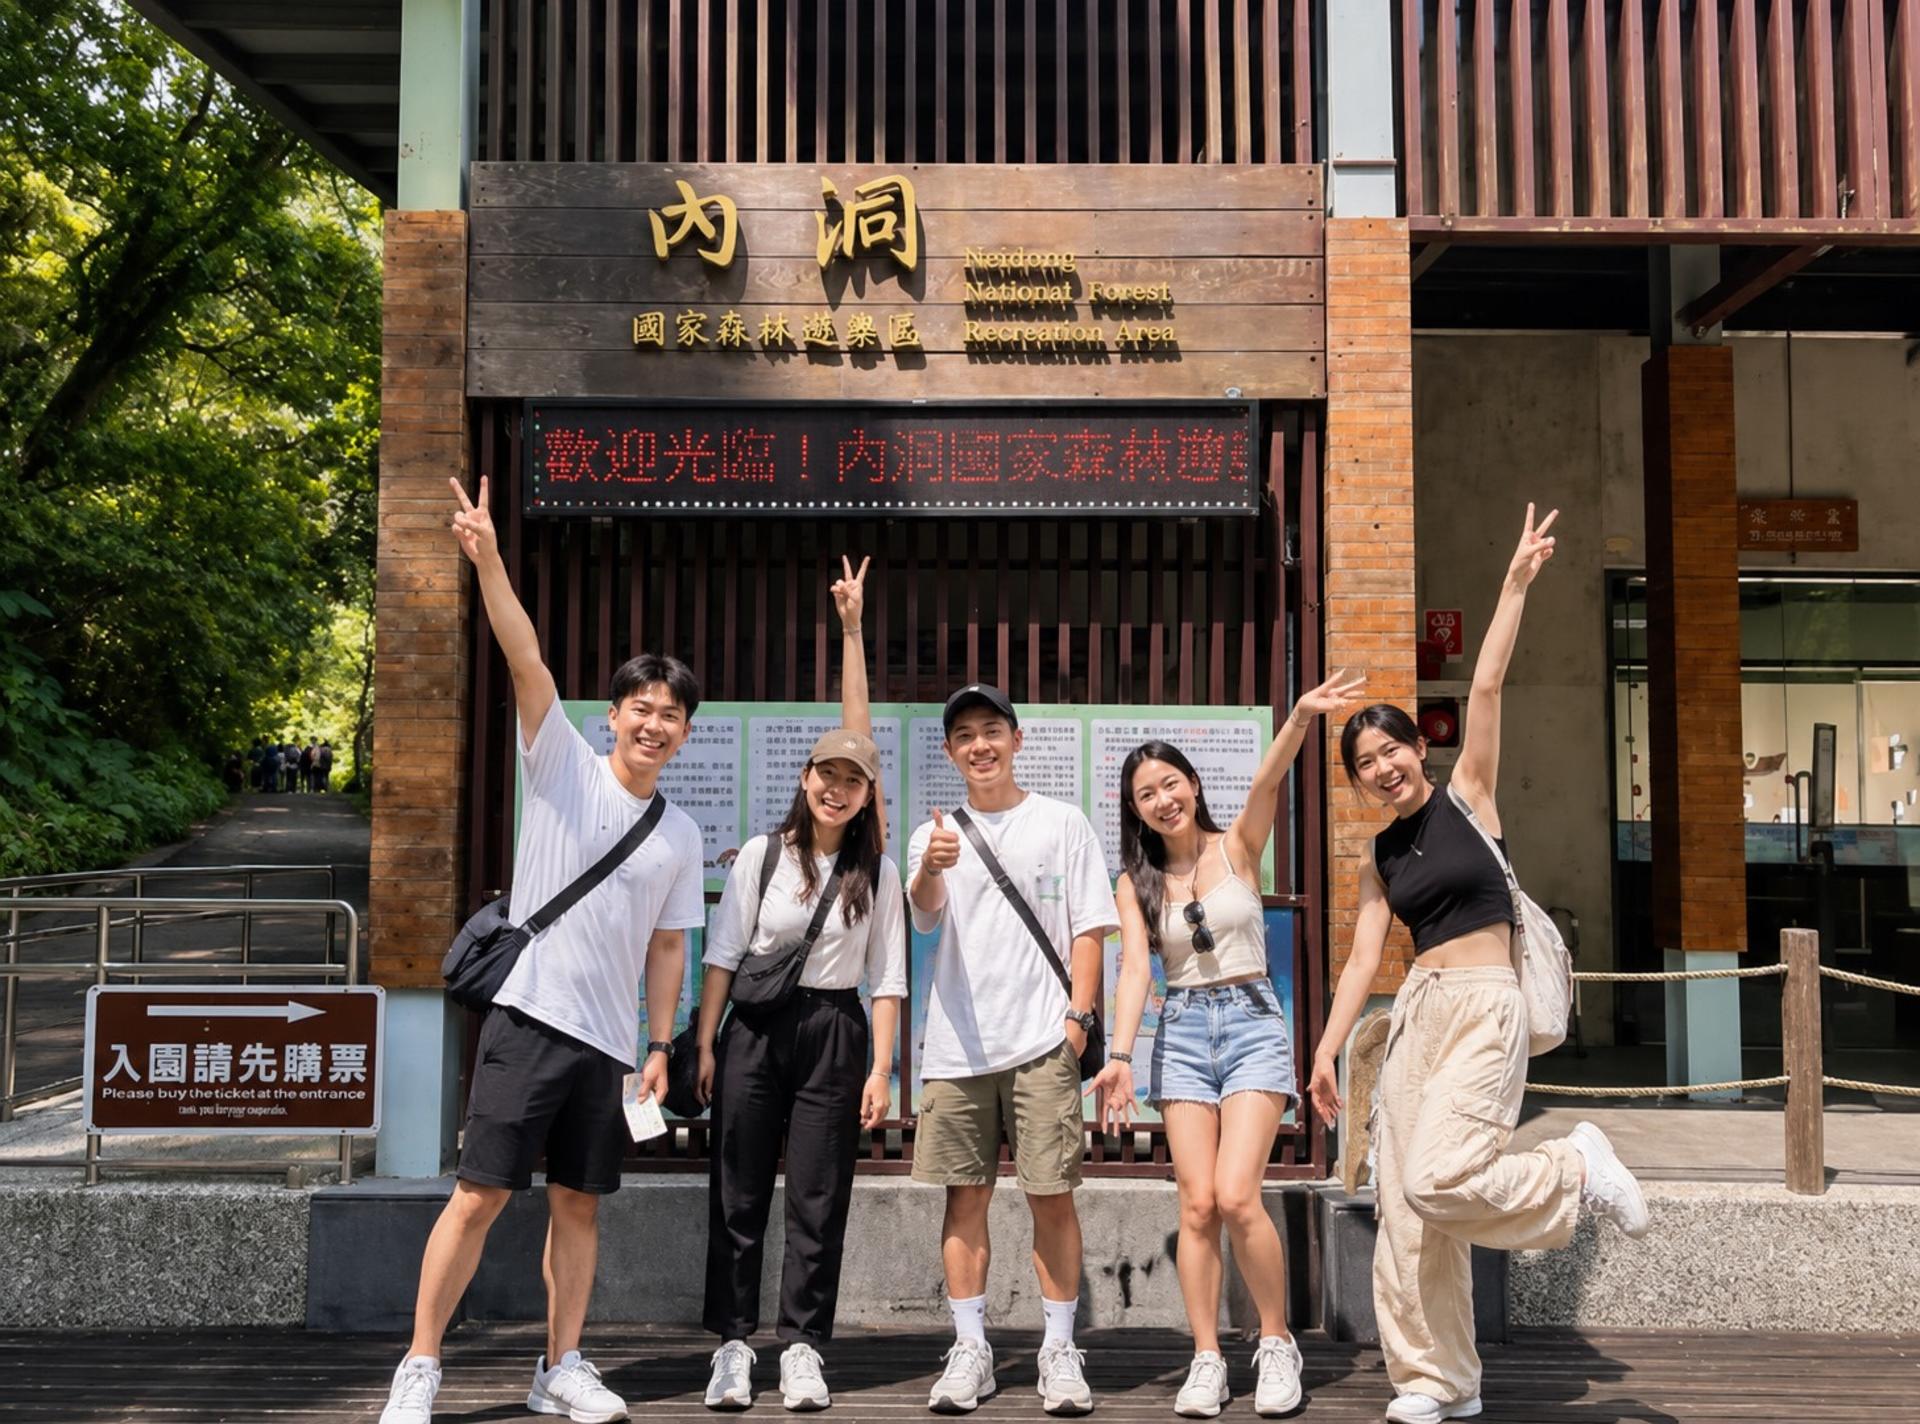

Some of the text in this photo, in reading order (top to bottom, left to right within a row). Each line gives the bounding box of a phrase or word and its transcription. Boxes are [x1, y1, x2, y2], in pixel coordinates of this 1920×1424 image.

[963, 247, 1076, 273] Neidong
[1088, 280, 1171, 301] Forest
[632, 309, 921, 347] 國家森林遊樂區
[963, 320, 1176, 342] Recreation Area
[102, 1042, 368, 1084] 入園請先購票
[102, 1087, 154, 1099] Please
[158, 1087, 187, 1101] buy
[214, 1087, 255, 1099] ticket
[257, 1089, 271, 1099] at
[273, 1088, 297, 1099] the
[299, 1089, 366, 1099] entrance
